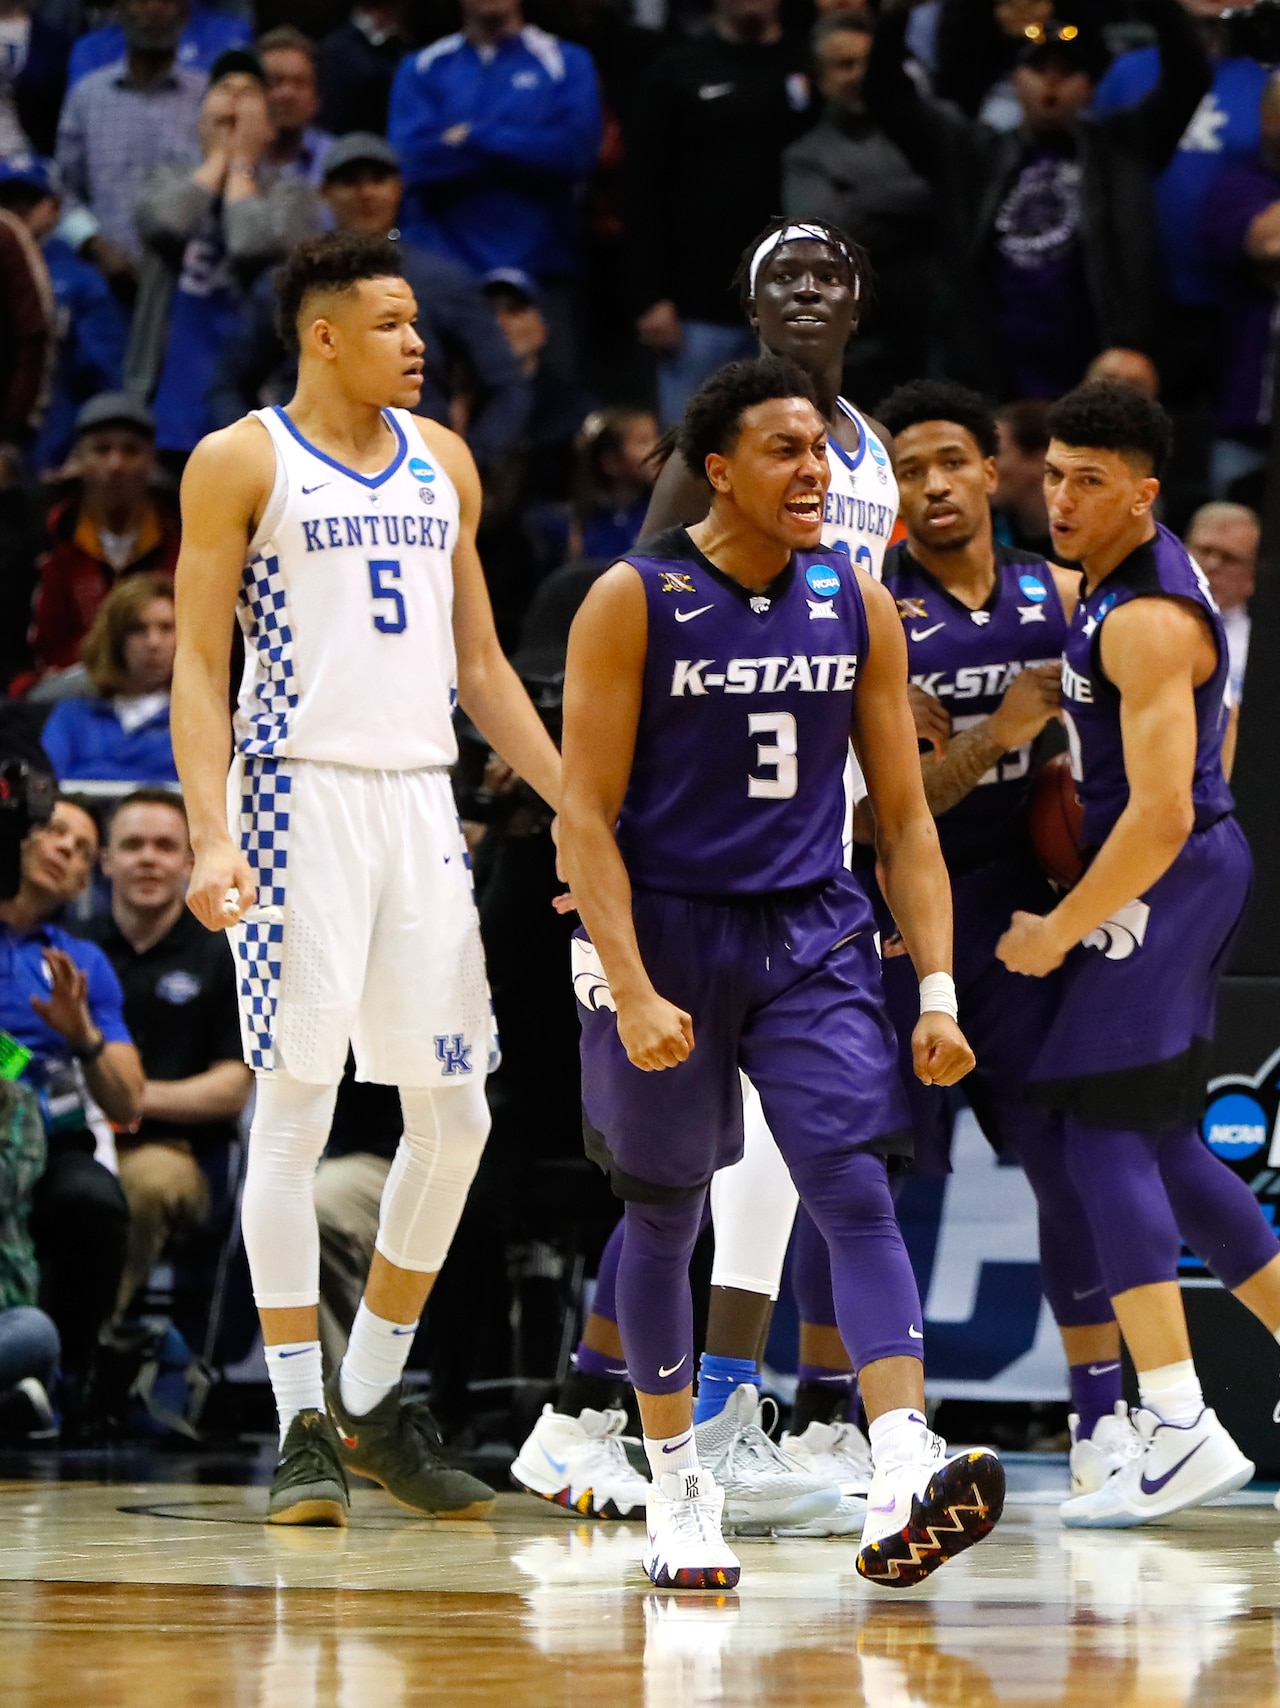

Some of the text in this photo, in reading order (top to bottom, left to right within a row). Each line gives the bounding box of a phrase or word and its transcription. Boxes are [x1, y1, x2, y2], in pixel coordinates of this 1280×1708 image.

[302, 515, 448, 552] KENTUCKY
[367, 560, 407, 634] 5
[811, 577, 841, 589] NCAA
[670, 655, 858, 697] K-STATE
[911, 657, 1062, 699] K-STA
[747, 711, 798, 799] 3
[433, 1034, 472, 1076] UK
[1208, 1124, 1266, 1144] NCAA
